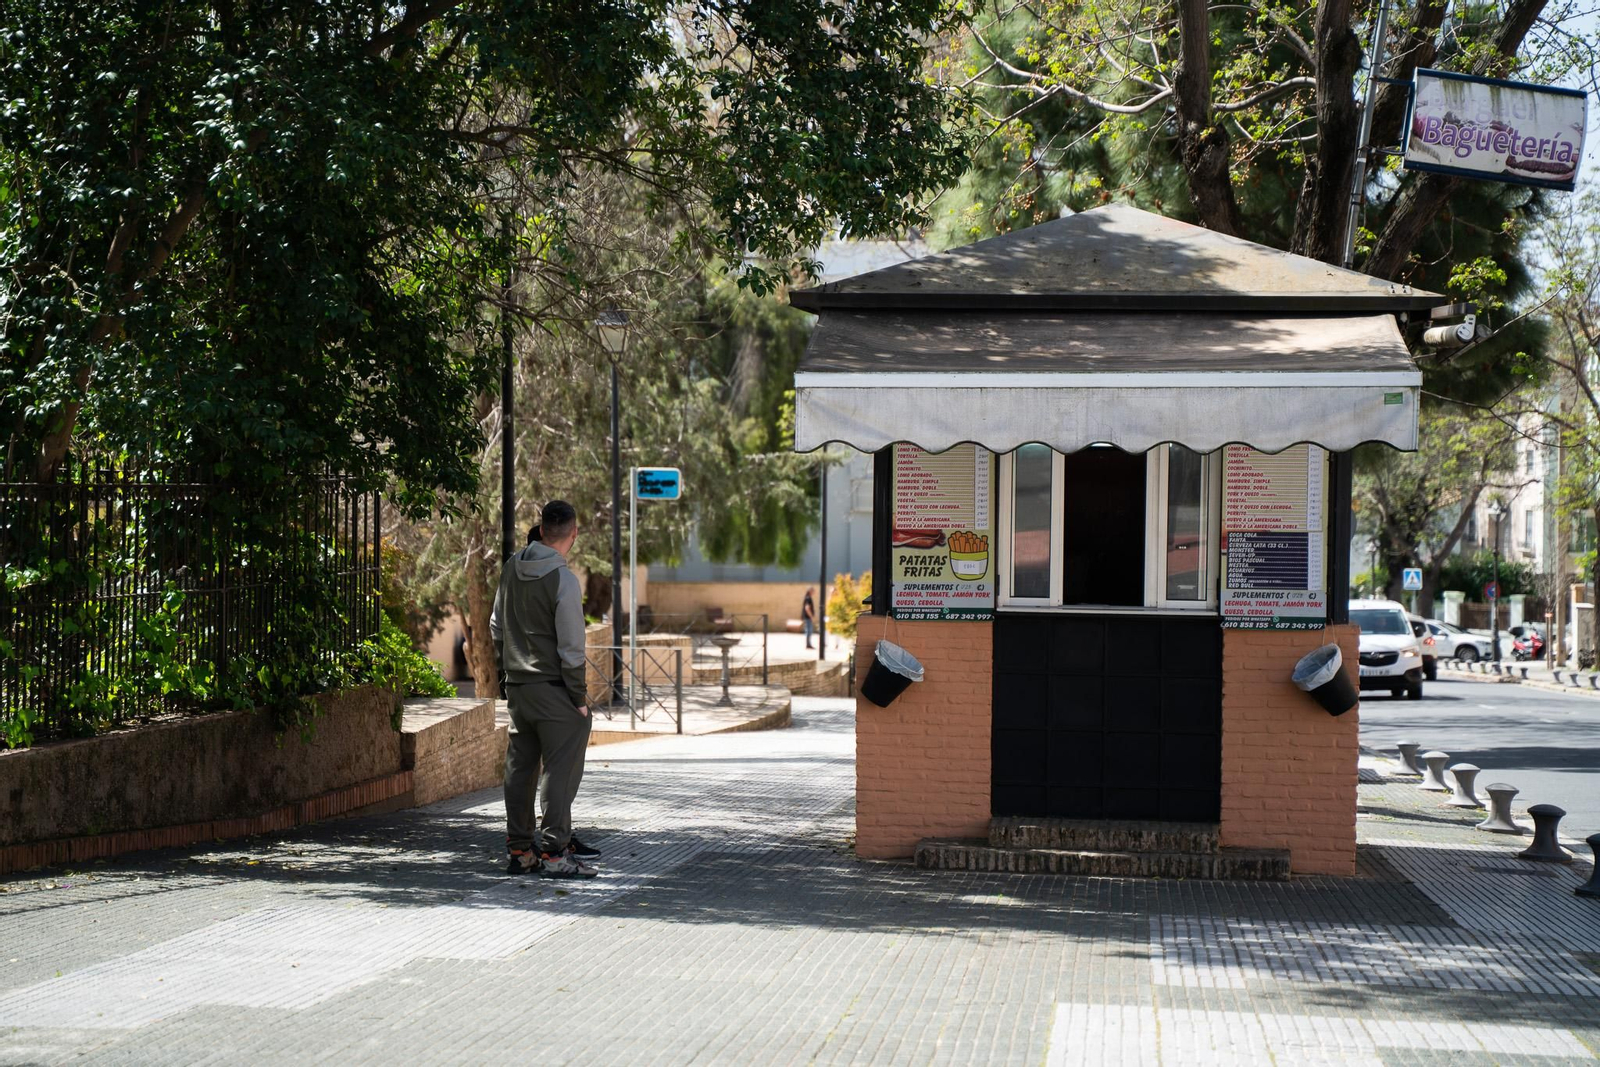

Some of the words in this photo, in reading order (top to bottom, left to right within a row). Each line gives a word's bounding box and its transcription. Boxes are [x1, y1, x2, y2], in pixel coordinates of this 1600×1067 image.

[1423, 116, 1574, 162] Baguetería
[899, 555, 947, 566] PATATAS
[904, 567, 942, 577] FRITAS
